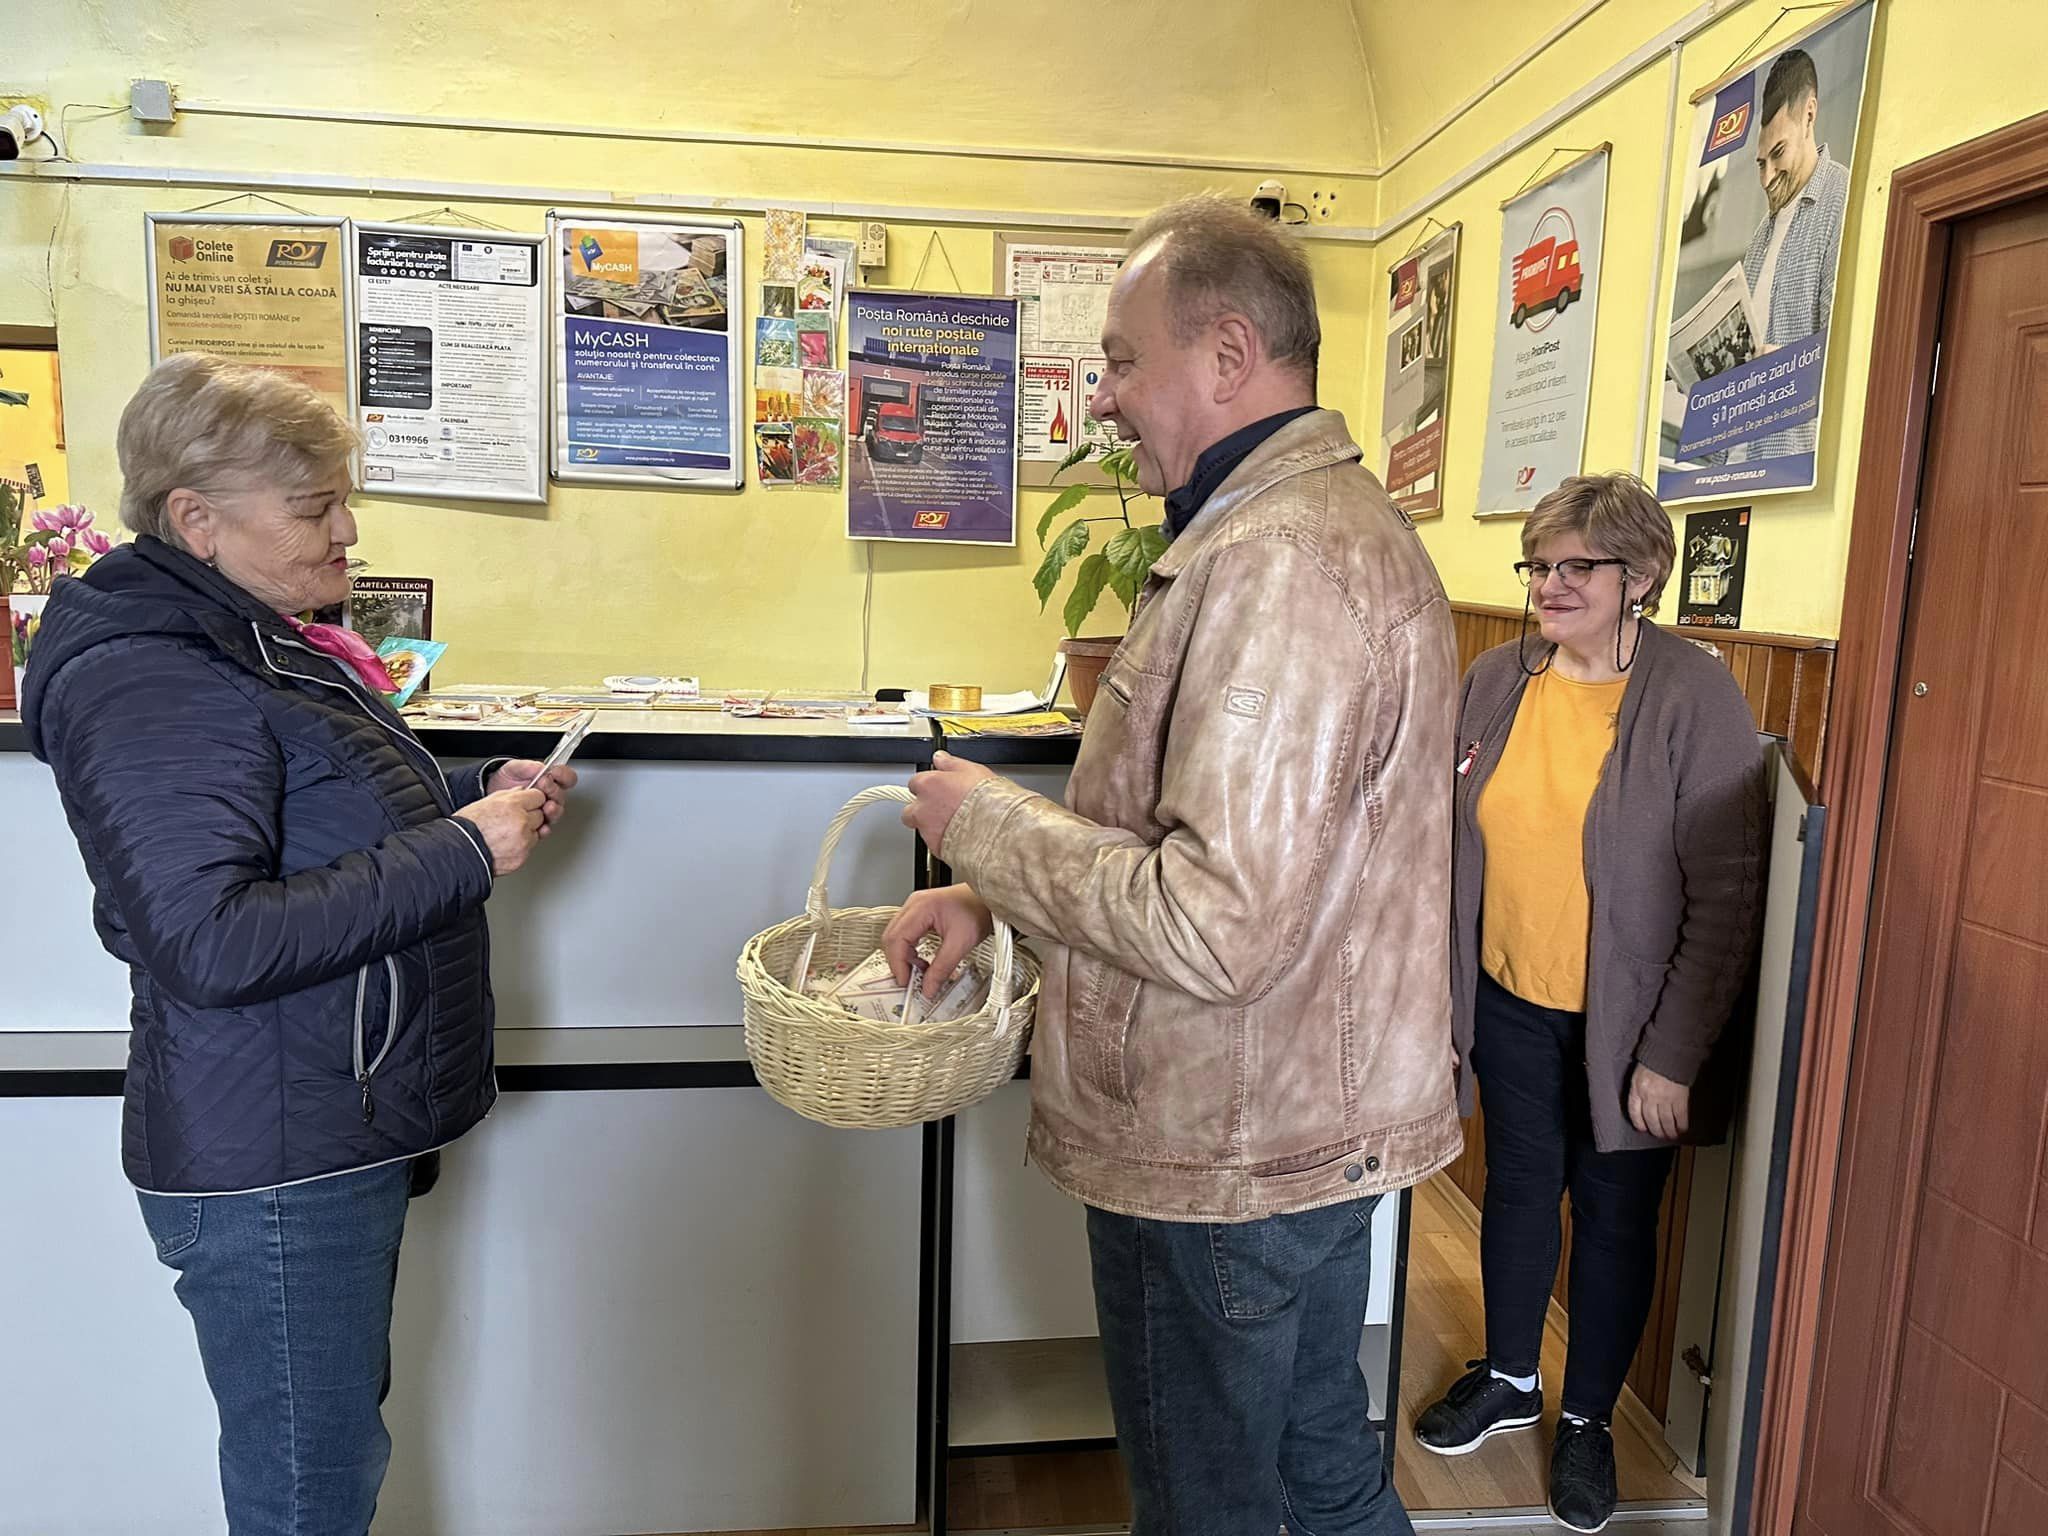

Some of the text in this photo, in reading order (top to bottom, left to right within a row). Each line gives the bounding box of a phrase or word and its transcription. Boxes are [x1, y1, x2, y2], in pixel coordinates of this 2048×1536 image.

[196, 240, 234, 252] Colete
[196, 251, 234, 263] Online
[367, 247, 447, 261] Sprijin pentru plata
[367, 257, 447, 271] facturilor la energie
[591, 263, 632, 273] MyCASH
[165, 272, 272, 286] Ai de trimis un colet și
[165, 284, 337, 298] NU MAI VREI SĂ STAI LA COADĂ
[166, 295, 216, 306] la ghișeu?
[166, 311, 200, 319] Comandă
[857, 307, 1010, 327] Poșta Română deschide
[575, 331, 649, 348] MyCASH
[882, 325, 985, 342] noi rute poștale
[887, 340, 979, 357] internaționale
[575, 349, 720, 363] soluția noastră pentru colectarea
[575, 359, 715, 371] numerarului și transferul în cont
[1045, 379, 1070, 390] 112
[1690, 344, 1821, 411] Comandă online ziarul dorit
[441, 382, 472, 390] IMPORTANT
[1711, 407, 1720, 428] și
[1727, 388, 1767, 425] primești
[1767, 380, 1798, 405] acasă.
[388, 434, 429, 445] 0319966
[1695, 469, 1767, 486] www.posta-romana.ro
[354, 581, 428, 590] CARTELA TELEKOM
[1691, 614, 1714, 627] Orange
[1714, 614, 1739, 627] PrePay
